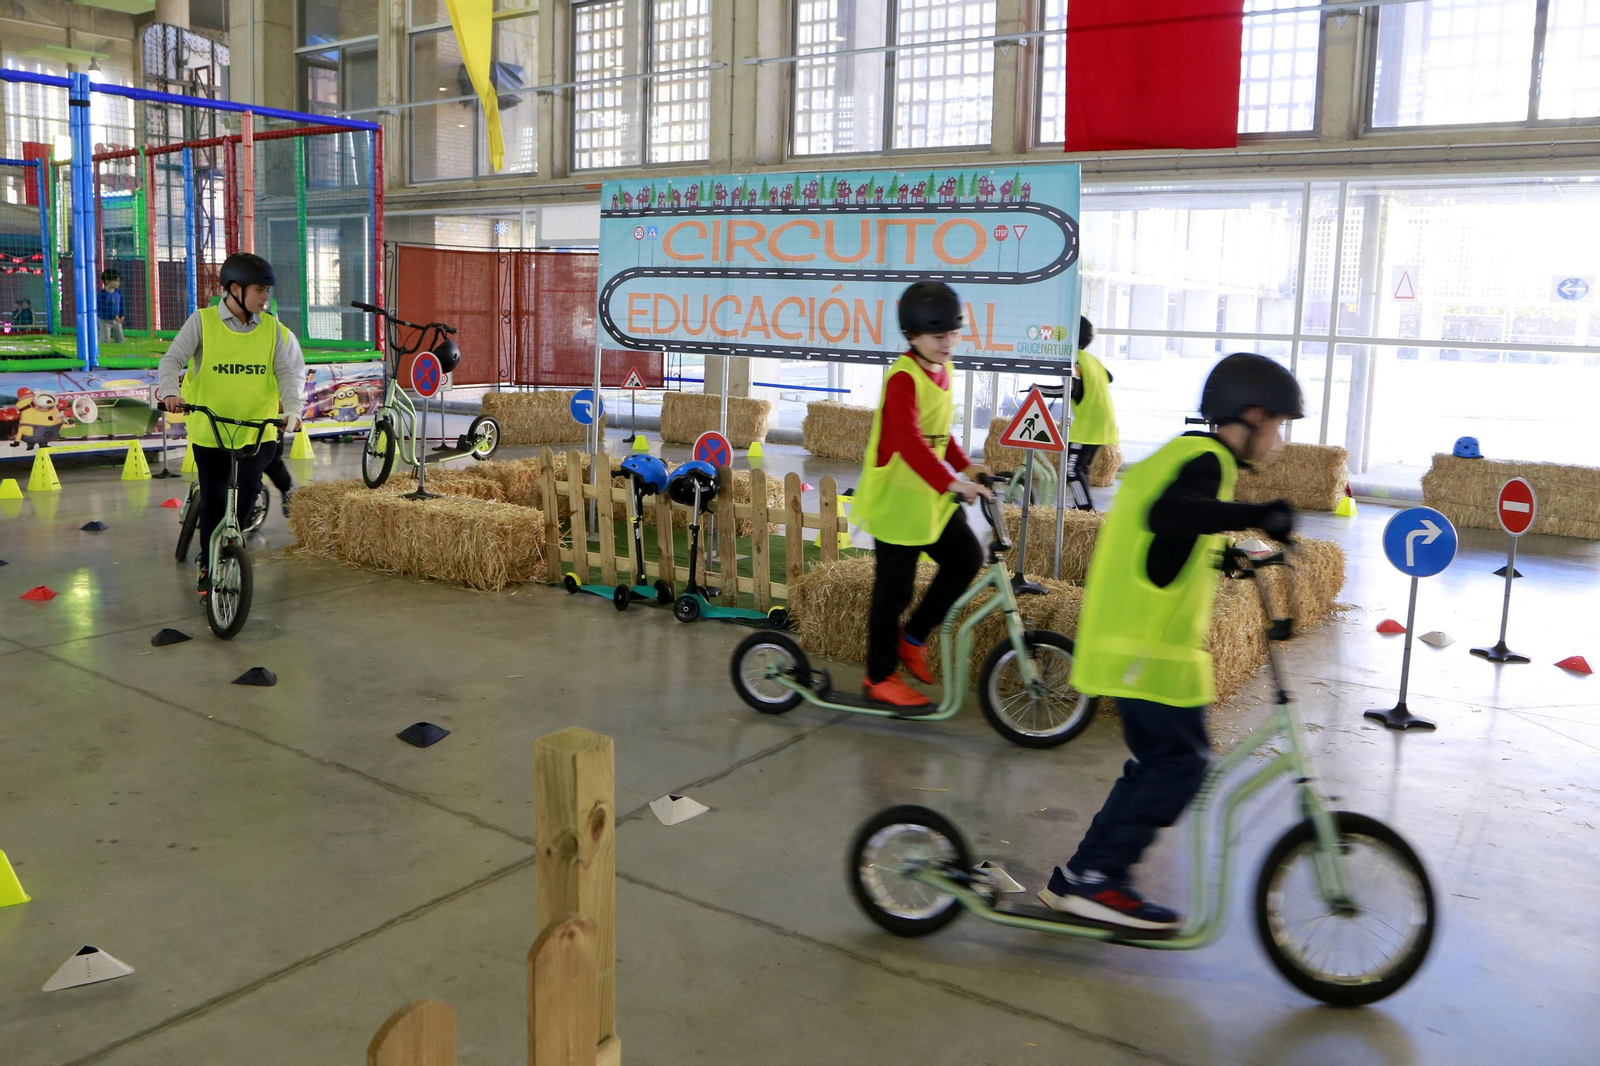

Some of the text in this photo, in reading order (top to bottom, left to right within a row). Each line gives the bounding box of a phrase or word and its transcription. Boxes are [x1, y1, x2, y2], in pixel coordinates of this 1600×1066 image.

[662, 219, 987, 264] CIRCUITO
[995, 229, 1009, 237] STOP
[627, 283, 1014, 352] EDUCACIÓN AL
